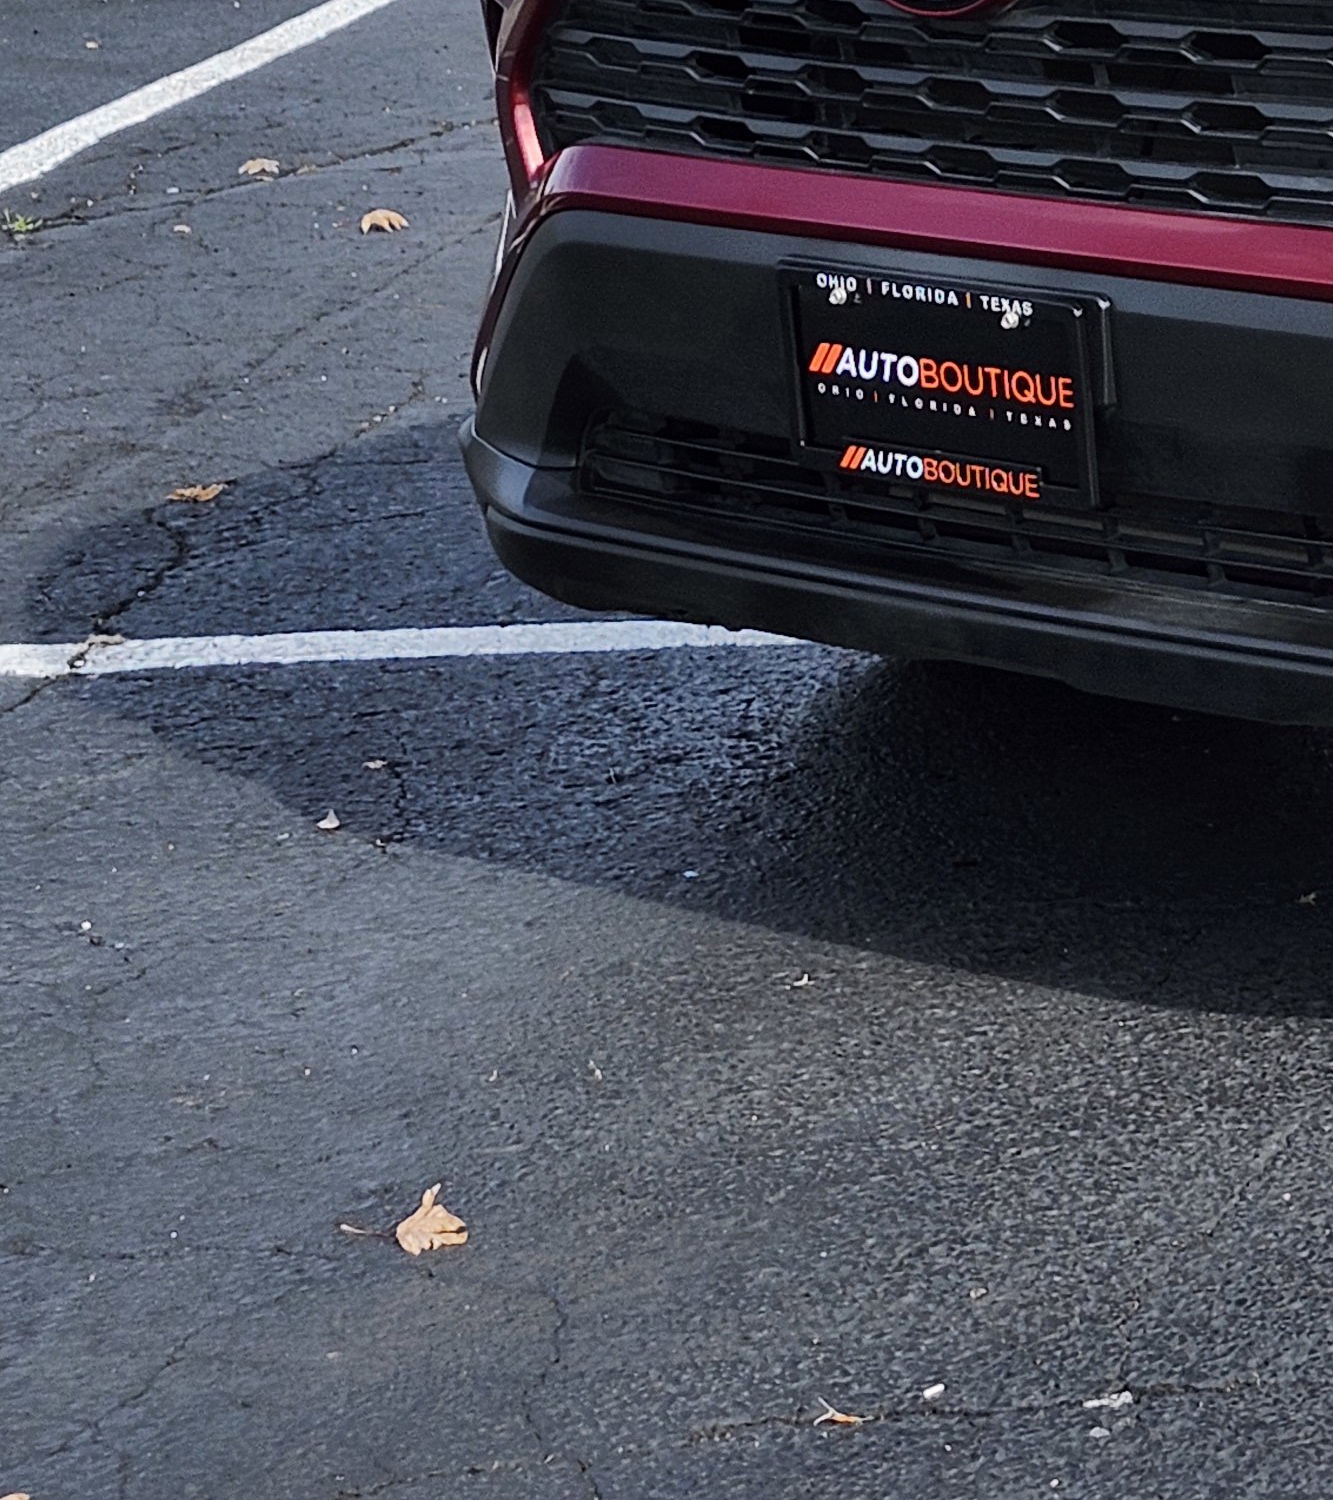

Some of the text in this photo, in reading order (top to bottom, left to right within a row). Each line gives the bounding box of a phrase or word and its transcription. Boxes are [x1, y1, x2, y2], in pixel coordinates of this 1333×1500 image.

[816, 272, 1034, 317] OHIO FLORIDA TEXAS
[888, 392, 977, 417] FLORIDA
[1006, 410, 1072, 431] TEXAS
